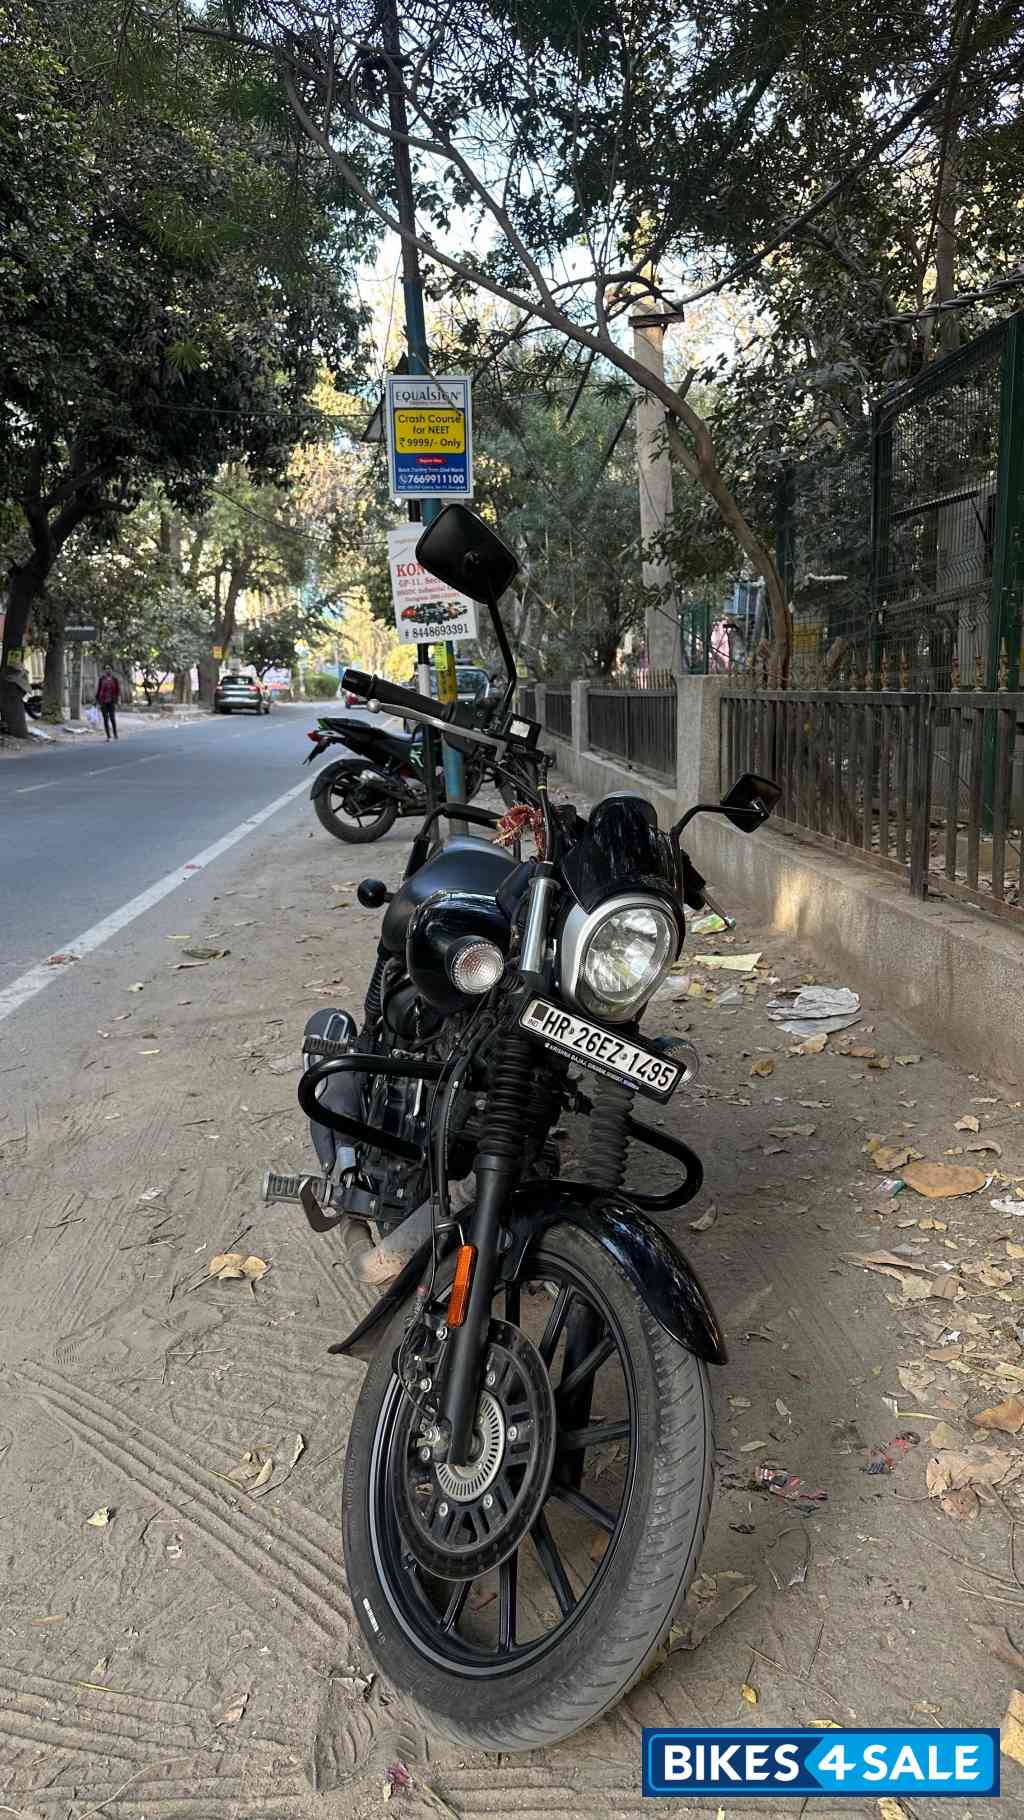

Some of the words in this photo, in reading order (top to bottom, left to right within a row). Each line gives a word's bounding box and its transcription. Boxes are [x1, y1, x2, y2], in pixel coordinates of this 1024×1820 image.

[398, 414, 425, 423] Crash
[428, 414, 461, 423] Course
[413, 426, 424, 434] for
[429, 426, 449, 434] NEET
[440, 438, 461, 449] Only
[407, 474, 465, 484] 7669911100
[542, 1010, 571, 1040] HR
[572, 1026, 624, 1064] 26EZ
[628, 1052, 674, 1087] 1495
